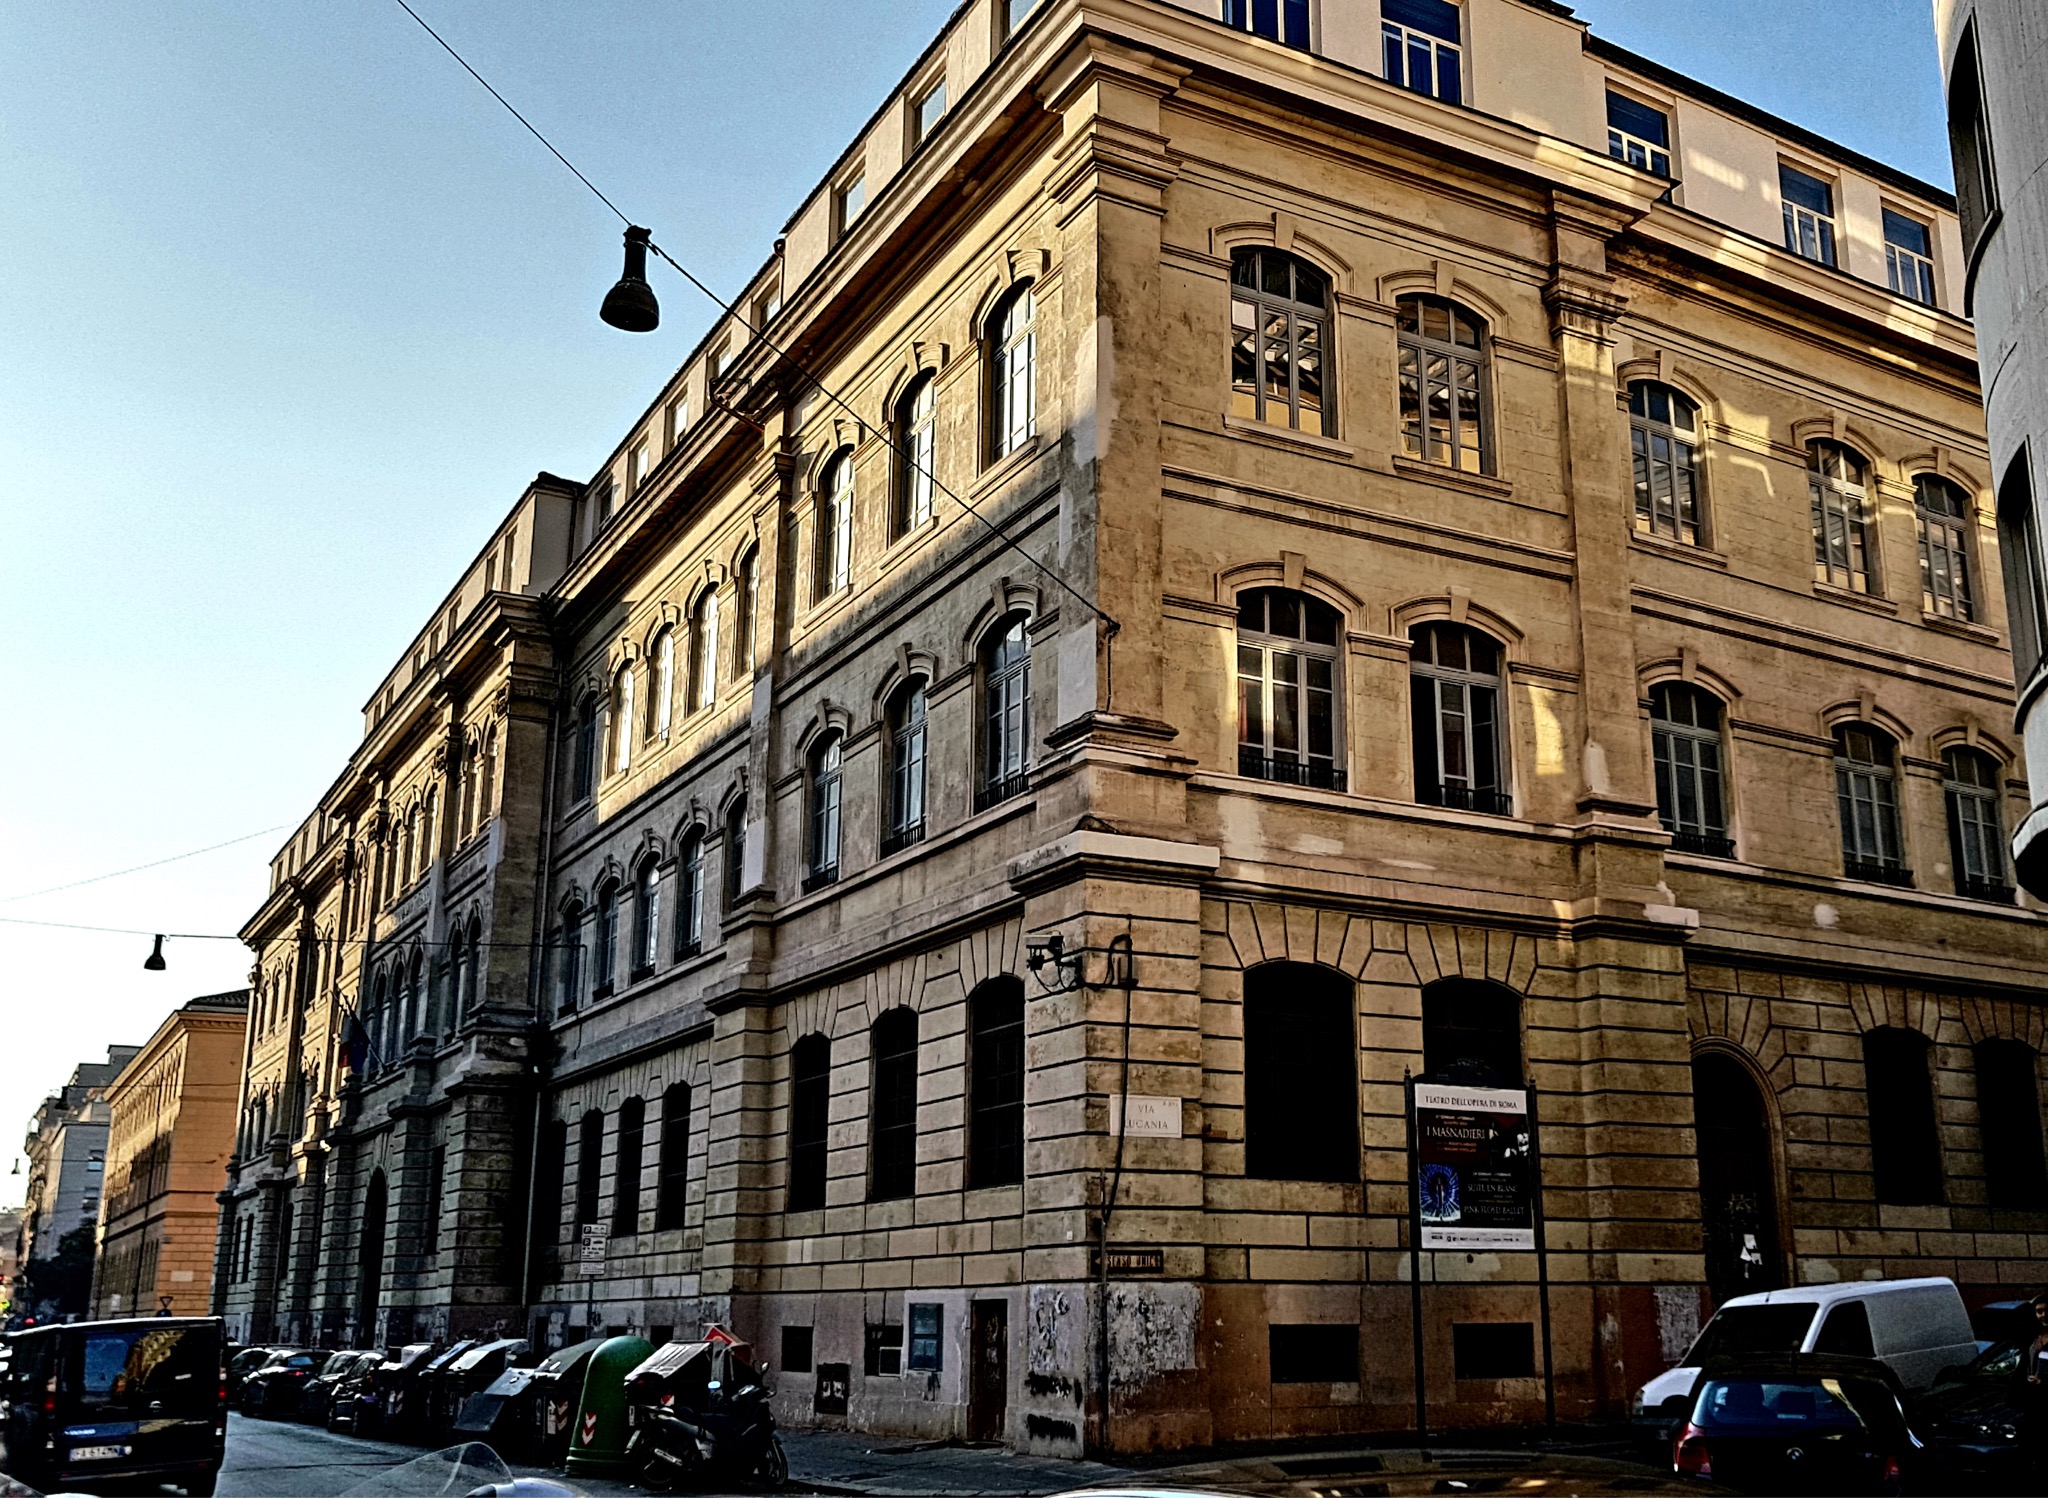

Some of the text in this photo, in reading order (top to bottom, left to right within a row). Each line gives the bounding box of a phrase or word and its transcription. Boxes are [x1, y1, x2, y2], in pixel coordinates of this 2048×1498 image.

[1425, 1095, 1450, 1105] TEATRO
[1489, 1100, 1497, 1108] DI
[1498, 1101, 1518, 1109] ROMA
[1138, 1104, 1155, 1114] VIA
[1432, 1126, 1486, 1139] MASNADIERI
